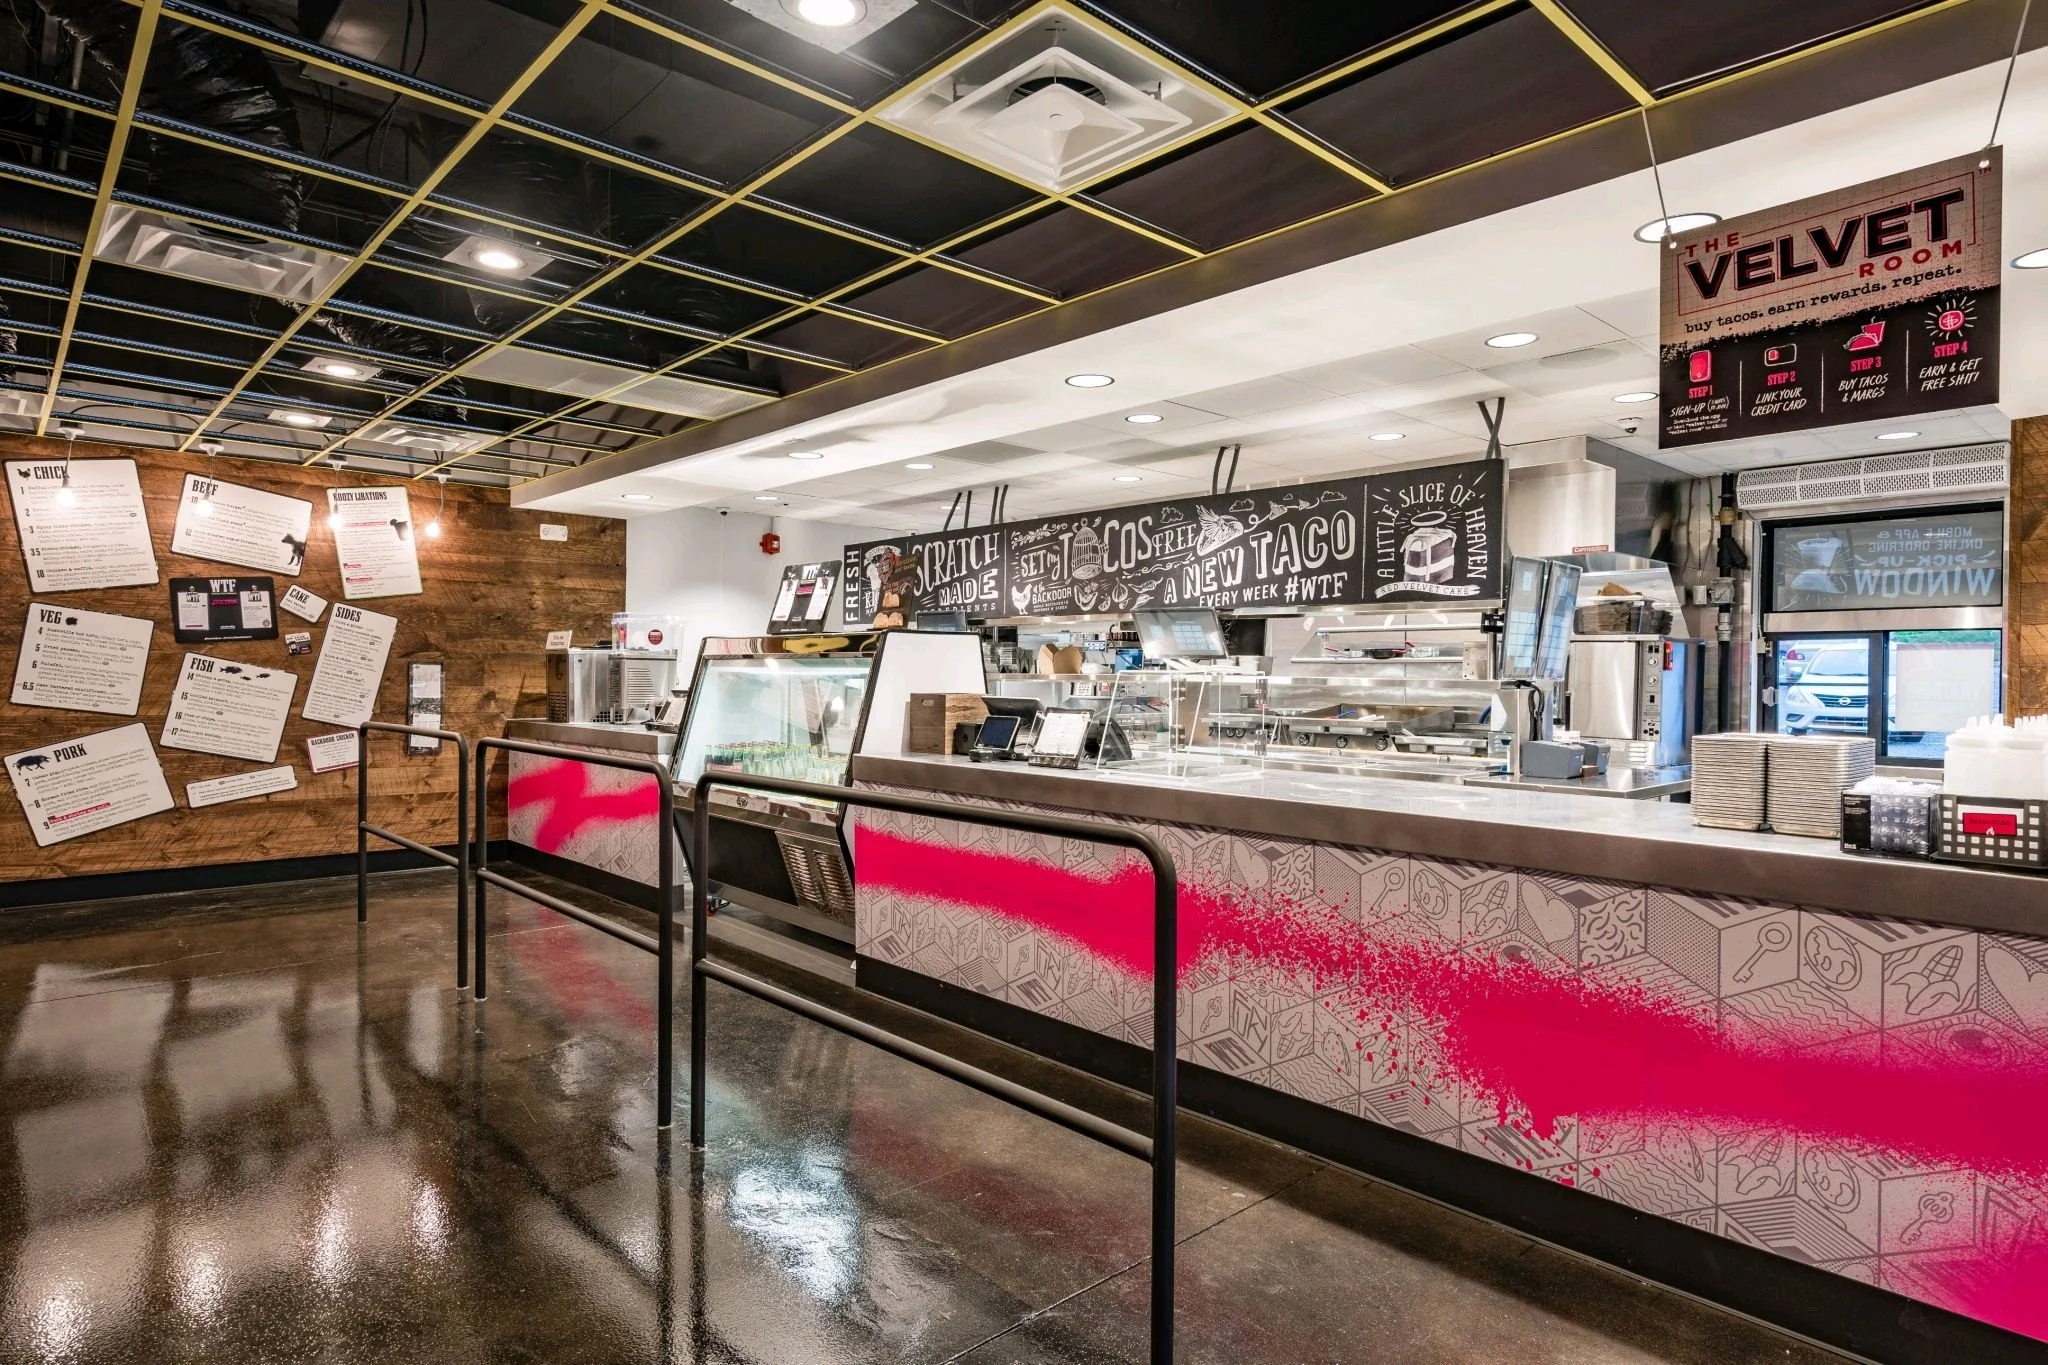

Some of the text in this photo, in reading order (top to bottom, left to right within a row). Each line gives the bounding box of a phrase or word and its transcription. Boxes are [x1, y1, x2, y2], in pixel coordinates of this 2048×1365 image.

[1684, 188, 1964, 299] VELVET
[1685, 232, 1739, 258] THE
[1860, 240, 1962, 278] ROOM
[1685, 264, 1962, 334] buy tacos. earn rewards. repeat.
[1934, 341, 1968, 358] STEP 4
[1851, 357, 1881, 372] STEP 3
[1920, 357, 1983, 378] EARN & GET
[1768, 371, 1796, 386] STEP 2
[1839, 373, 1888, 391] BUY TACOS
[1921, 372, 1979, 391] FREE SHIT!
[1689, 385, 1712, 398] STEP 1
[1756, 387, 1802, 404] LINK YOUR
[1842, 387, 1885, 402] & MARGS
[1670, 403, 1706, 417] SIGN-UP
[1751, 398, 1806, 416] CREDIT CARD
[34, 466, 70, 480] CHICK
[354, 492, 387, 501] LIBATIONS
[29, 526, 34, 534] 3
[1377, 482, 1488, 579] A LITTLE SLICE OF HEAVEN
[1021, 550, 1047, 577] SET
[1047, 552, 1060, 580] my
[1152, 524, 1198, 557] FREE
[1164, 510, 1355, 604] A NEW TACO
[912, 532, 1000, 597] SCRATCH
[209, 579, 236, 592] WTF
[846, 550, 859, 622] FRESH
[938, 568, 998, 606] MADE
[1200, 572, 1347, 607] EVERY WEEK #WTF
[1381, 583, 1469, 595] RED VELVET CAKE
[290, 588, 310, 604] CAKE
[1032, 587, 1072, 604] BACKDOOR
[40, 609, 62, 624] VEG
[336, 607, 362, 622] SIDES
[38, 627, 42, 635] 4
[35, 644, 40, 652] 5
[32, 660, 37, 668] 6
[190, 657, 215, 673] FISH
[187, 672, 194, 680] 14
[22, 682, 34, 690] 6.5
[181, 692, 188, 700] 15
[174, 712, 182, 720] 16
[171, 728, 179, 736] 17
[336, 733, 354, 741] CHICKEN
[53, 743, 87, 762] PORK
[25, 778, 30, 787] 7
[34, 800, 40, 808] 8
[43, 821, 50, 830] 9
